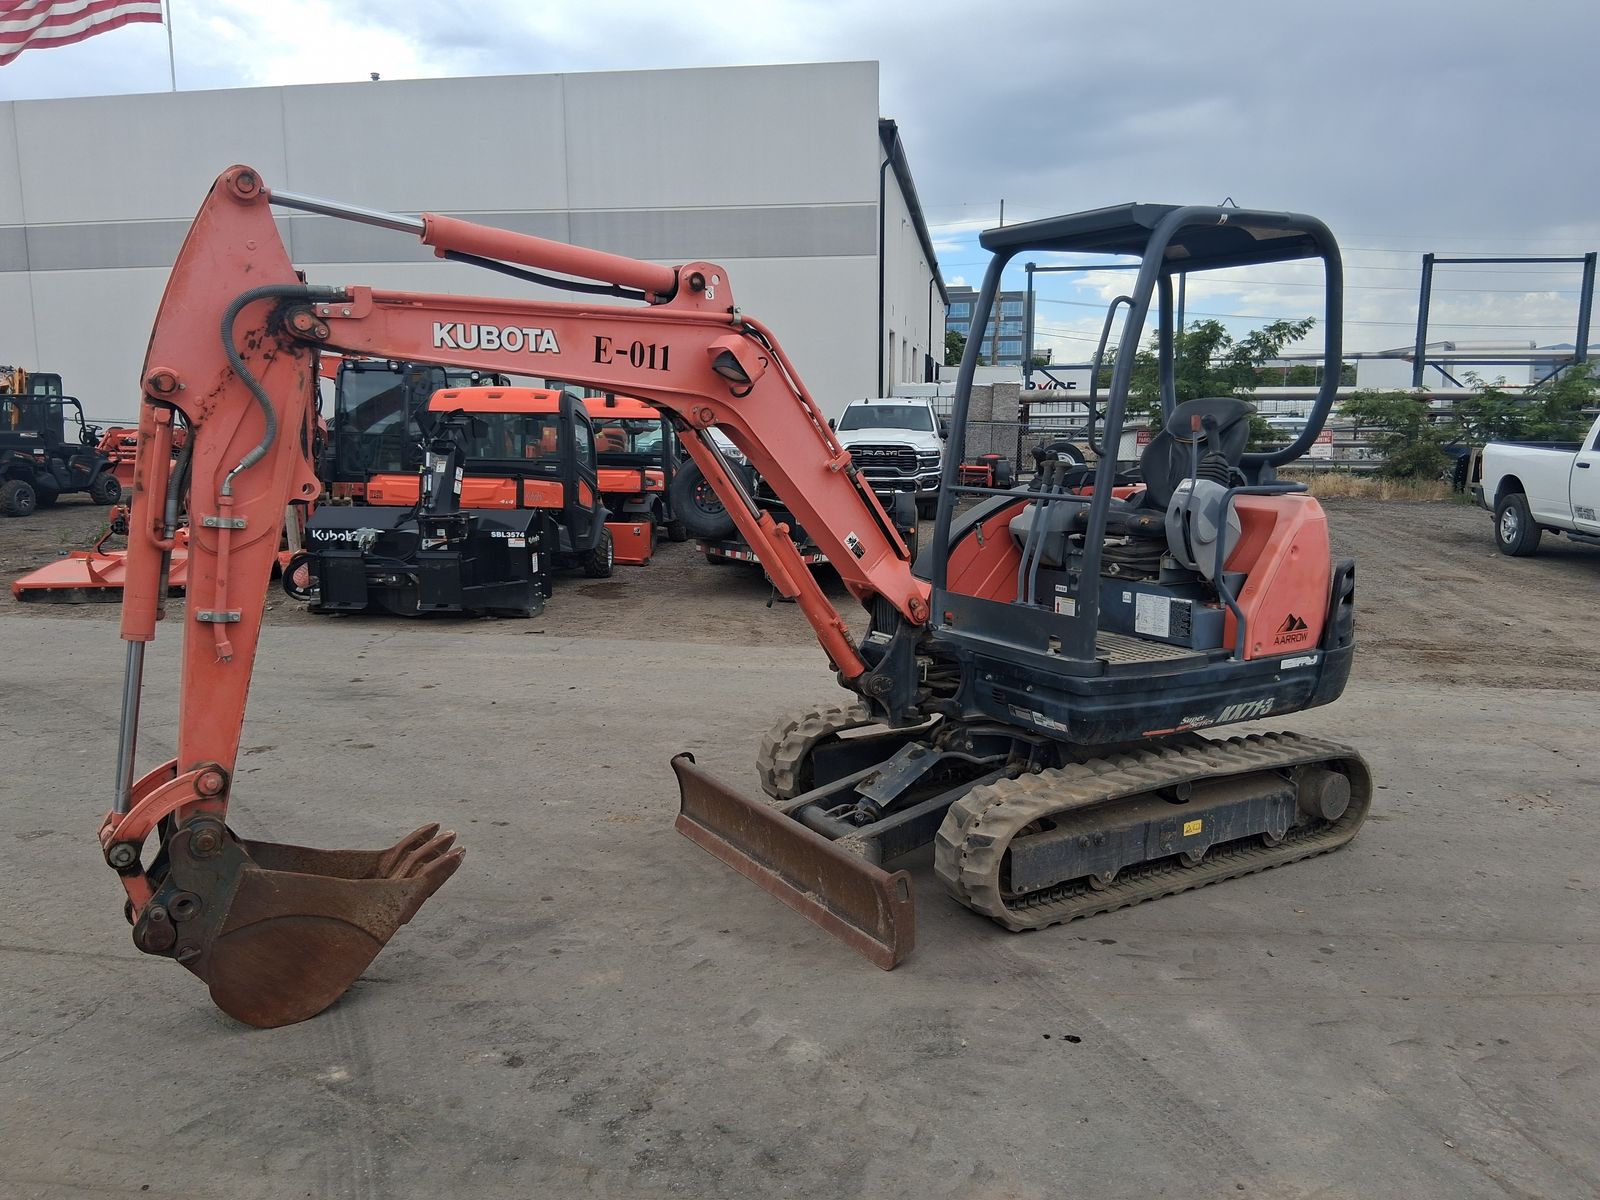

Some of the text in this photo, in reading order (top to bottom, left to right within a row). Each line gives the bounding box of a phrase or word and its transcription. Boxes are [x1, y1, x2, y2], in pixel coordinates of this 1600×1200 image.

[433, 322, 559, 353] KUBOTA
[592, 335, 671, 371] E-011
[1274, 632, 1308, 645] AARROW
